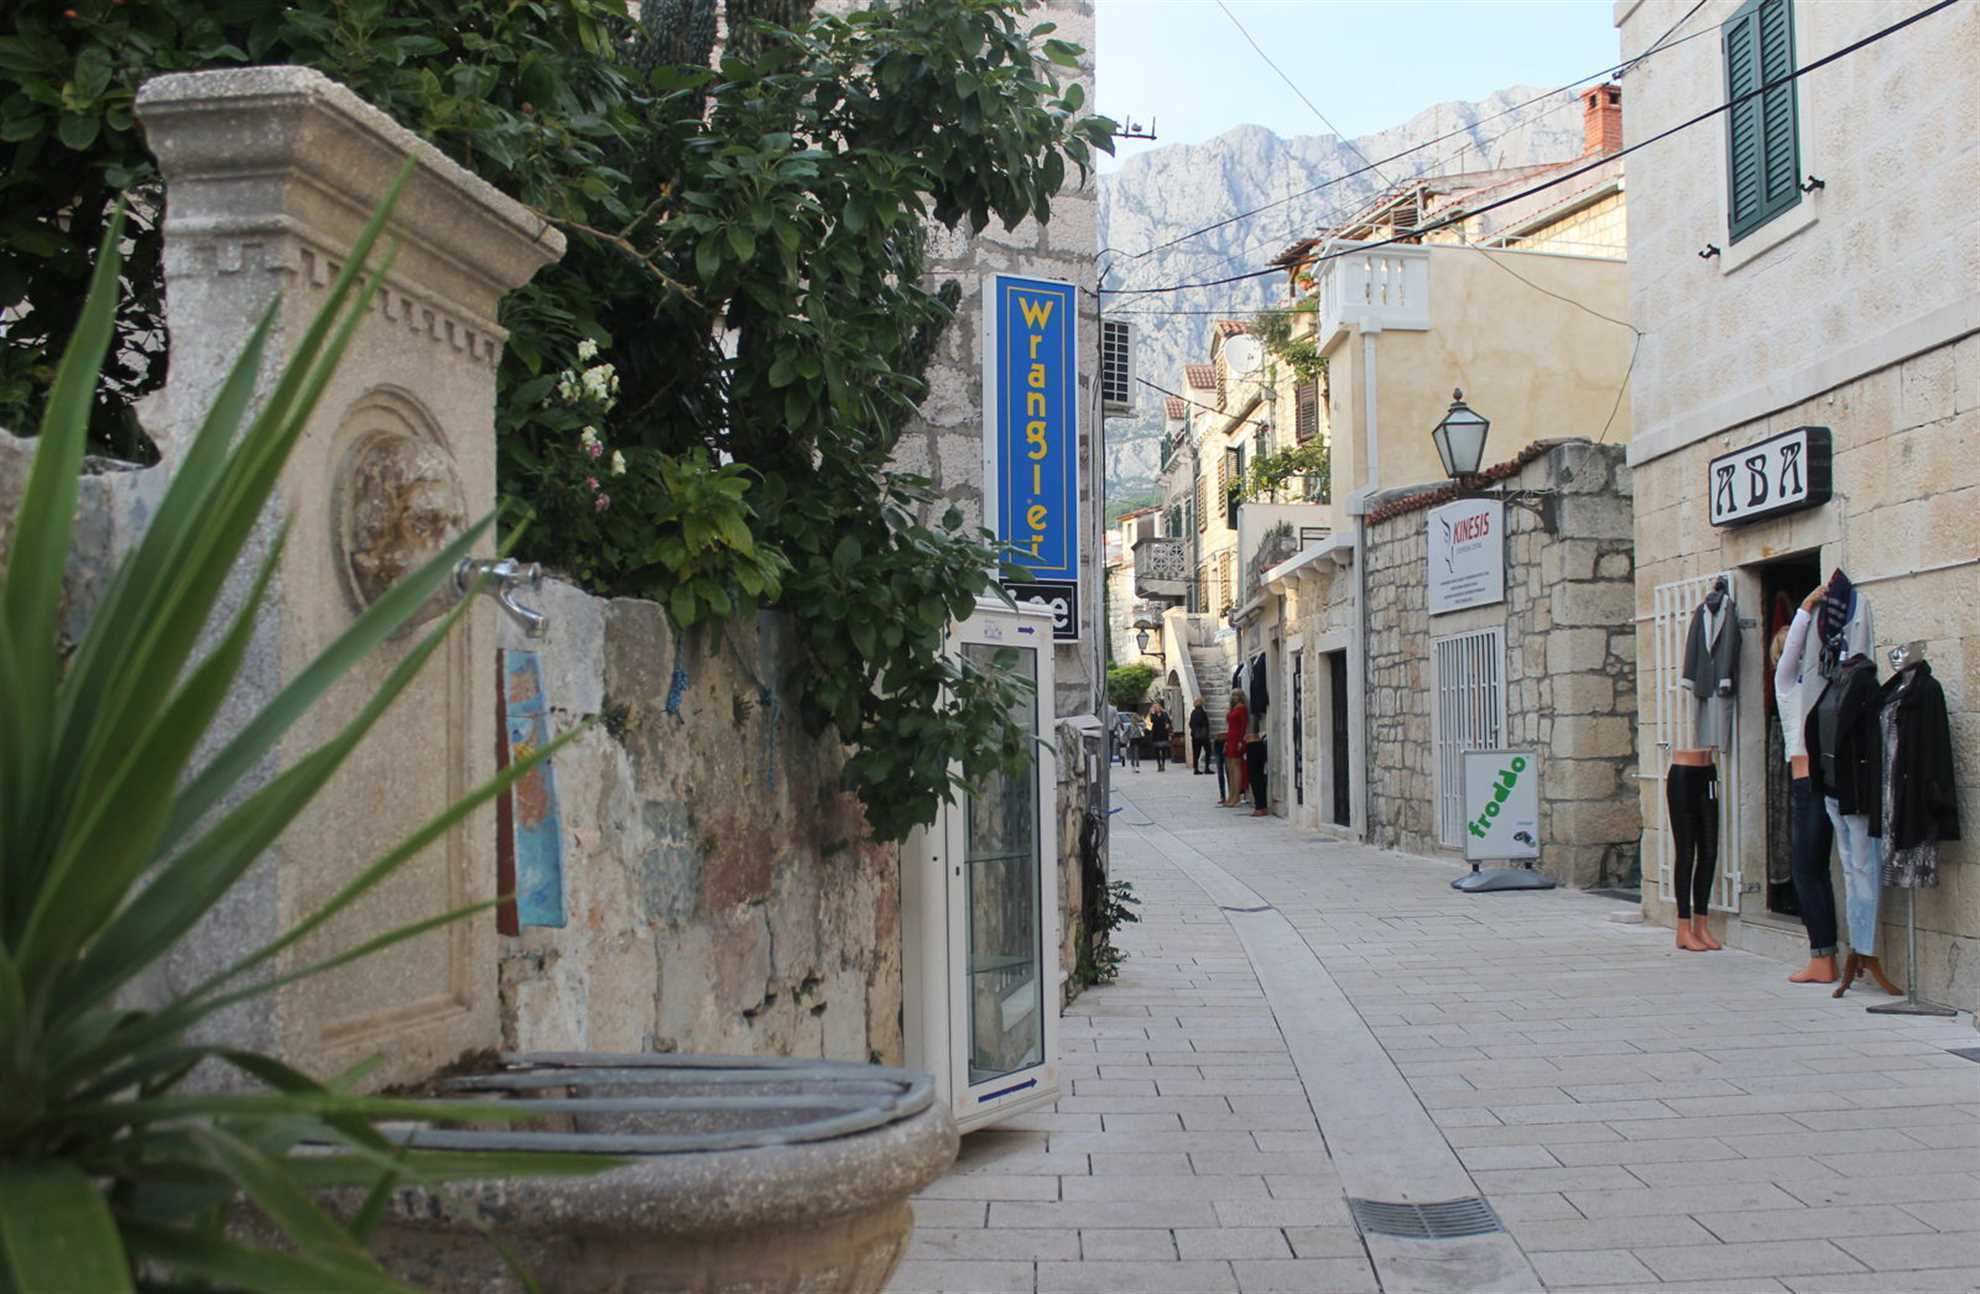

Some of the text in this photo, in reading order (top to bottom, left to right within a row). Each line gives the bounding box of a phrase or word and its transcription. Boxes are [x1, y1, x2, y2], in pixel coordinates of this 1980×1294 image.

[1018, 297, 1054, 558] Wrangler
[1716, 441, 1803, 516] ABA
[1453, 512, 1490, 544] KINESIS
[1468, 756, 1526, 839] froddo
